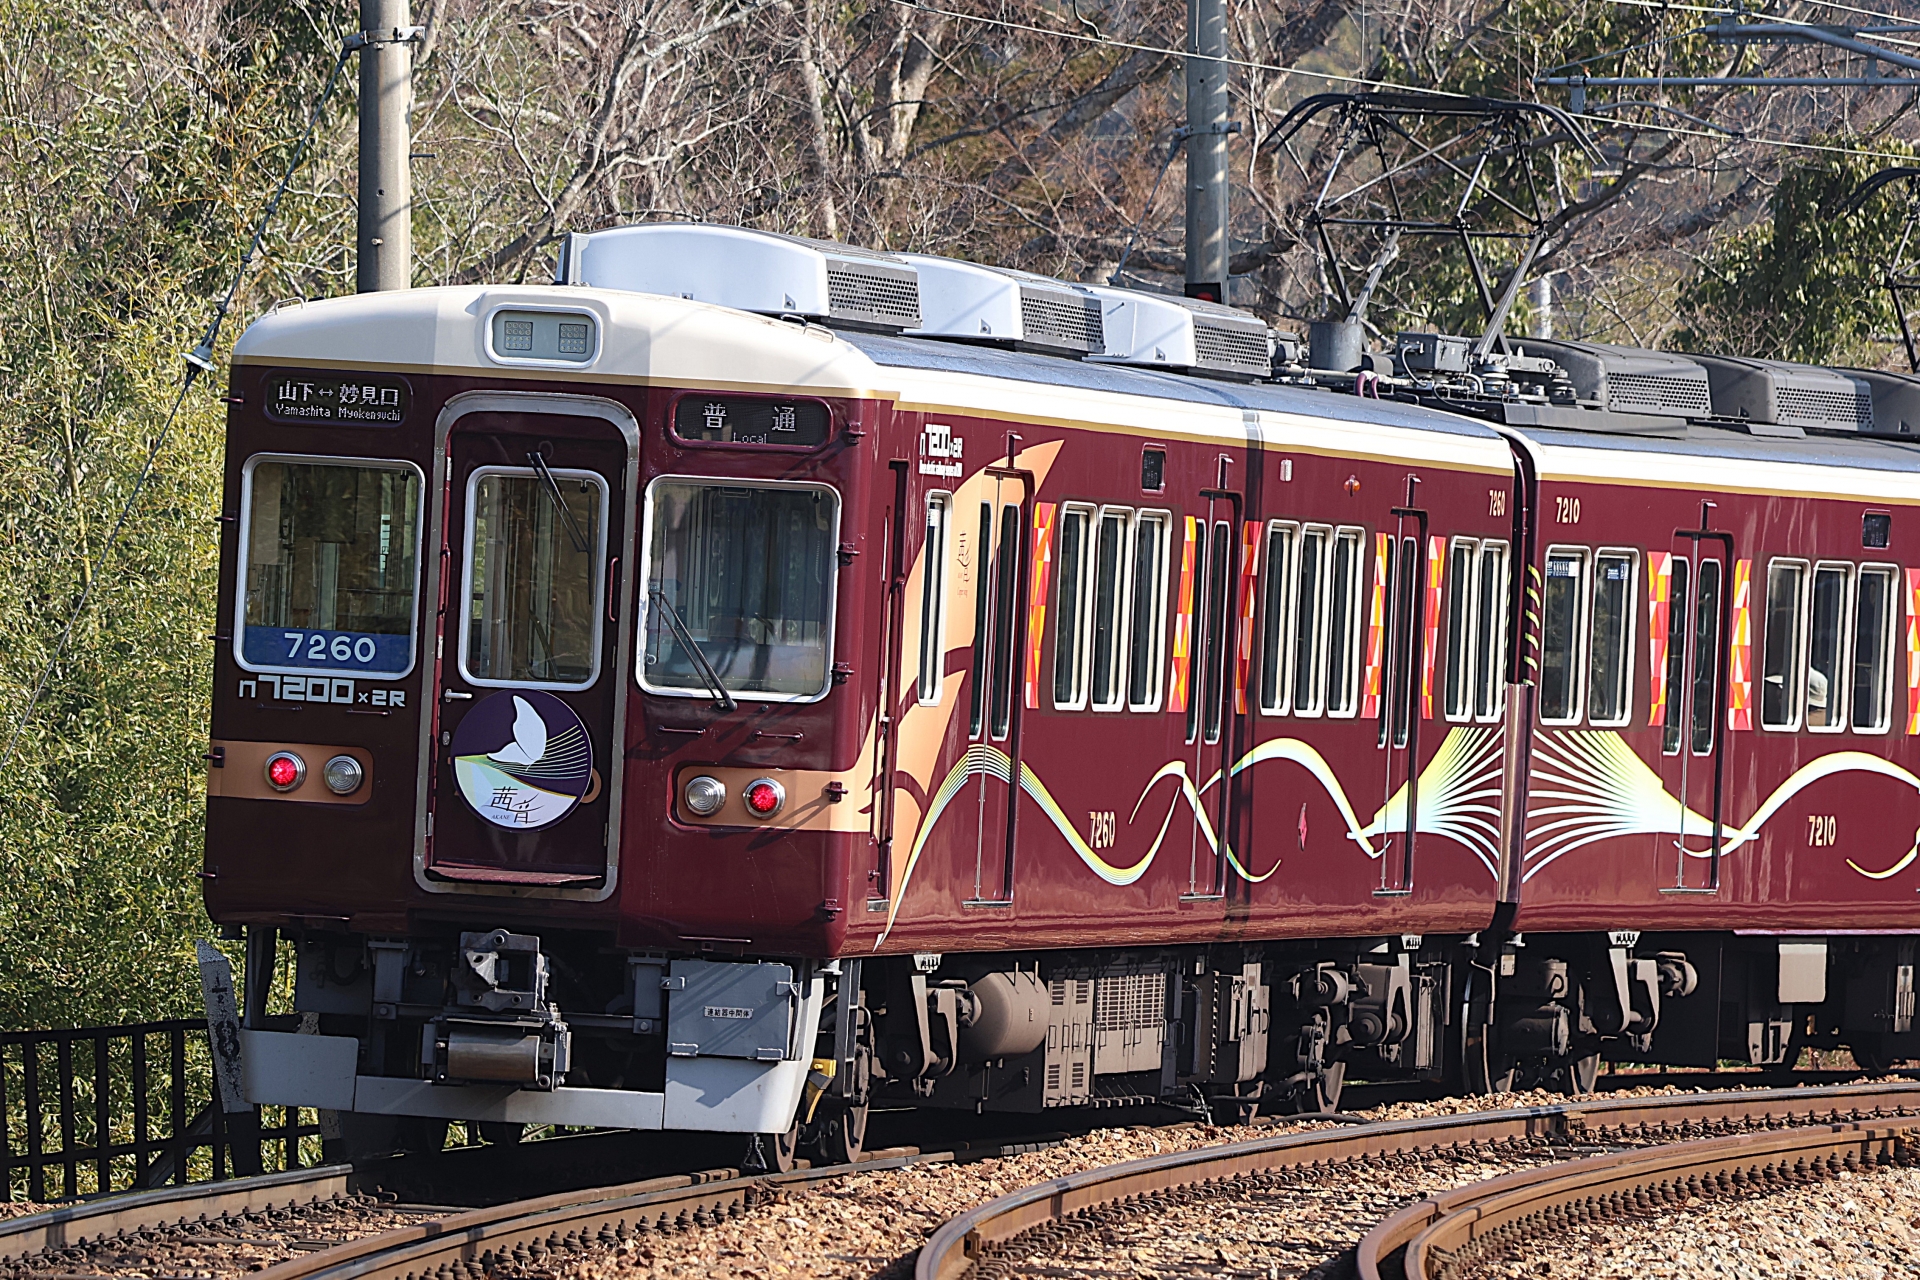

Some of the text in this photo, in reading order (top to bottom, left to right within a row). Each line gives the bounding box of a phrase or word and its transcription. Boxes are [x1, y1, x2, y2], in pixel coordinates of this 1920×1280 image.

[278, 380, 399, 407] 山下 妙見口
[275, 403, 401, 421] Yamashita Myokenguchi
[732, 431, 768, 444] Local
[1489, 489, 1506, 517] 7260
[1555, 496, 1581, 524] 7210
[284, 632, 377, 663] 7260
[1089, 811, 1116, 848] 7260
[1808, 816, 1836, 846] 7210
